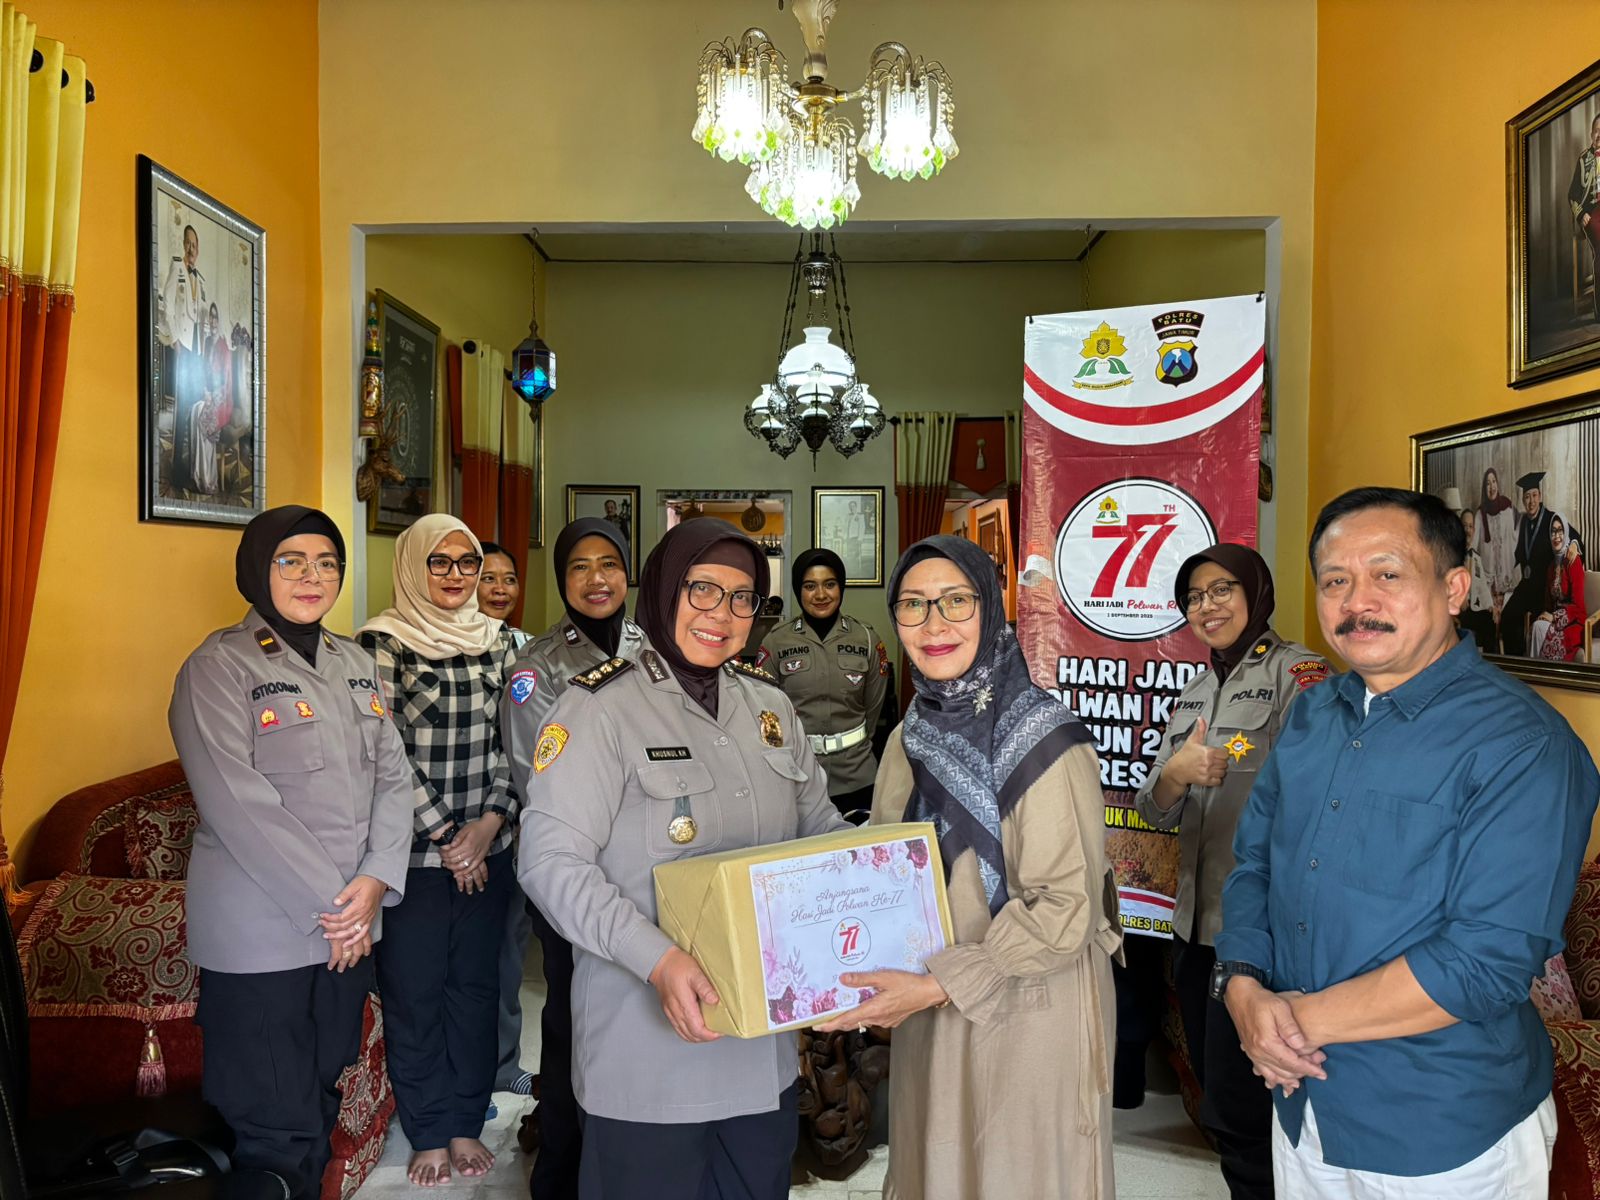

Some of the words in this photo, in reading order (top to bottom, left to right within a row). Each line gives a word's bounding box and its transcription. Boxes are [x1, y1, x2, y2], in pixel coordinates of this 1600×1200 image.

[1158, 312, 1199, 324] POLRES
[1163, 504, 1176, 512] TH
[1090, 513, 1178, 598] 77
[1083, 600, 1104, 608] HARI
[1127, 599, 1163, 609] Polwan
[837, 644, 868, 657] POLRI
[1058, 657, 1127, 687] HARI
[1229, 688, 1274, 703] POLRI
[836, 900, 869, 913] Polwan
[839, 924, 860, 956] 77
